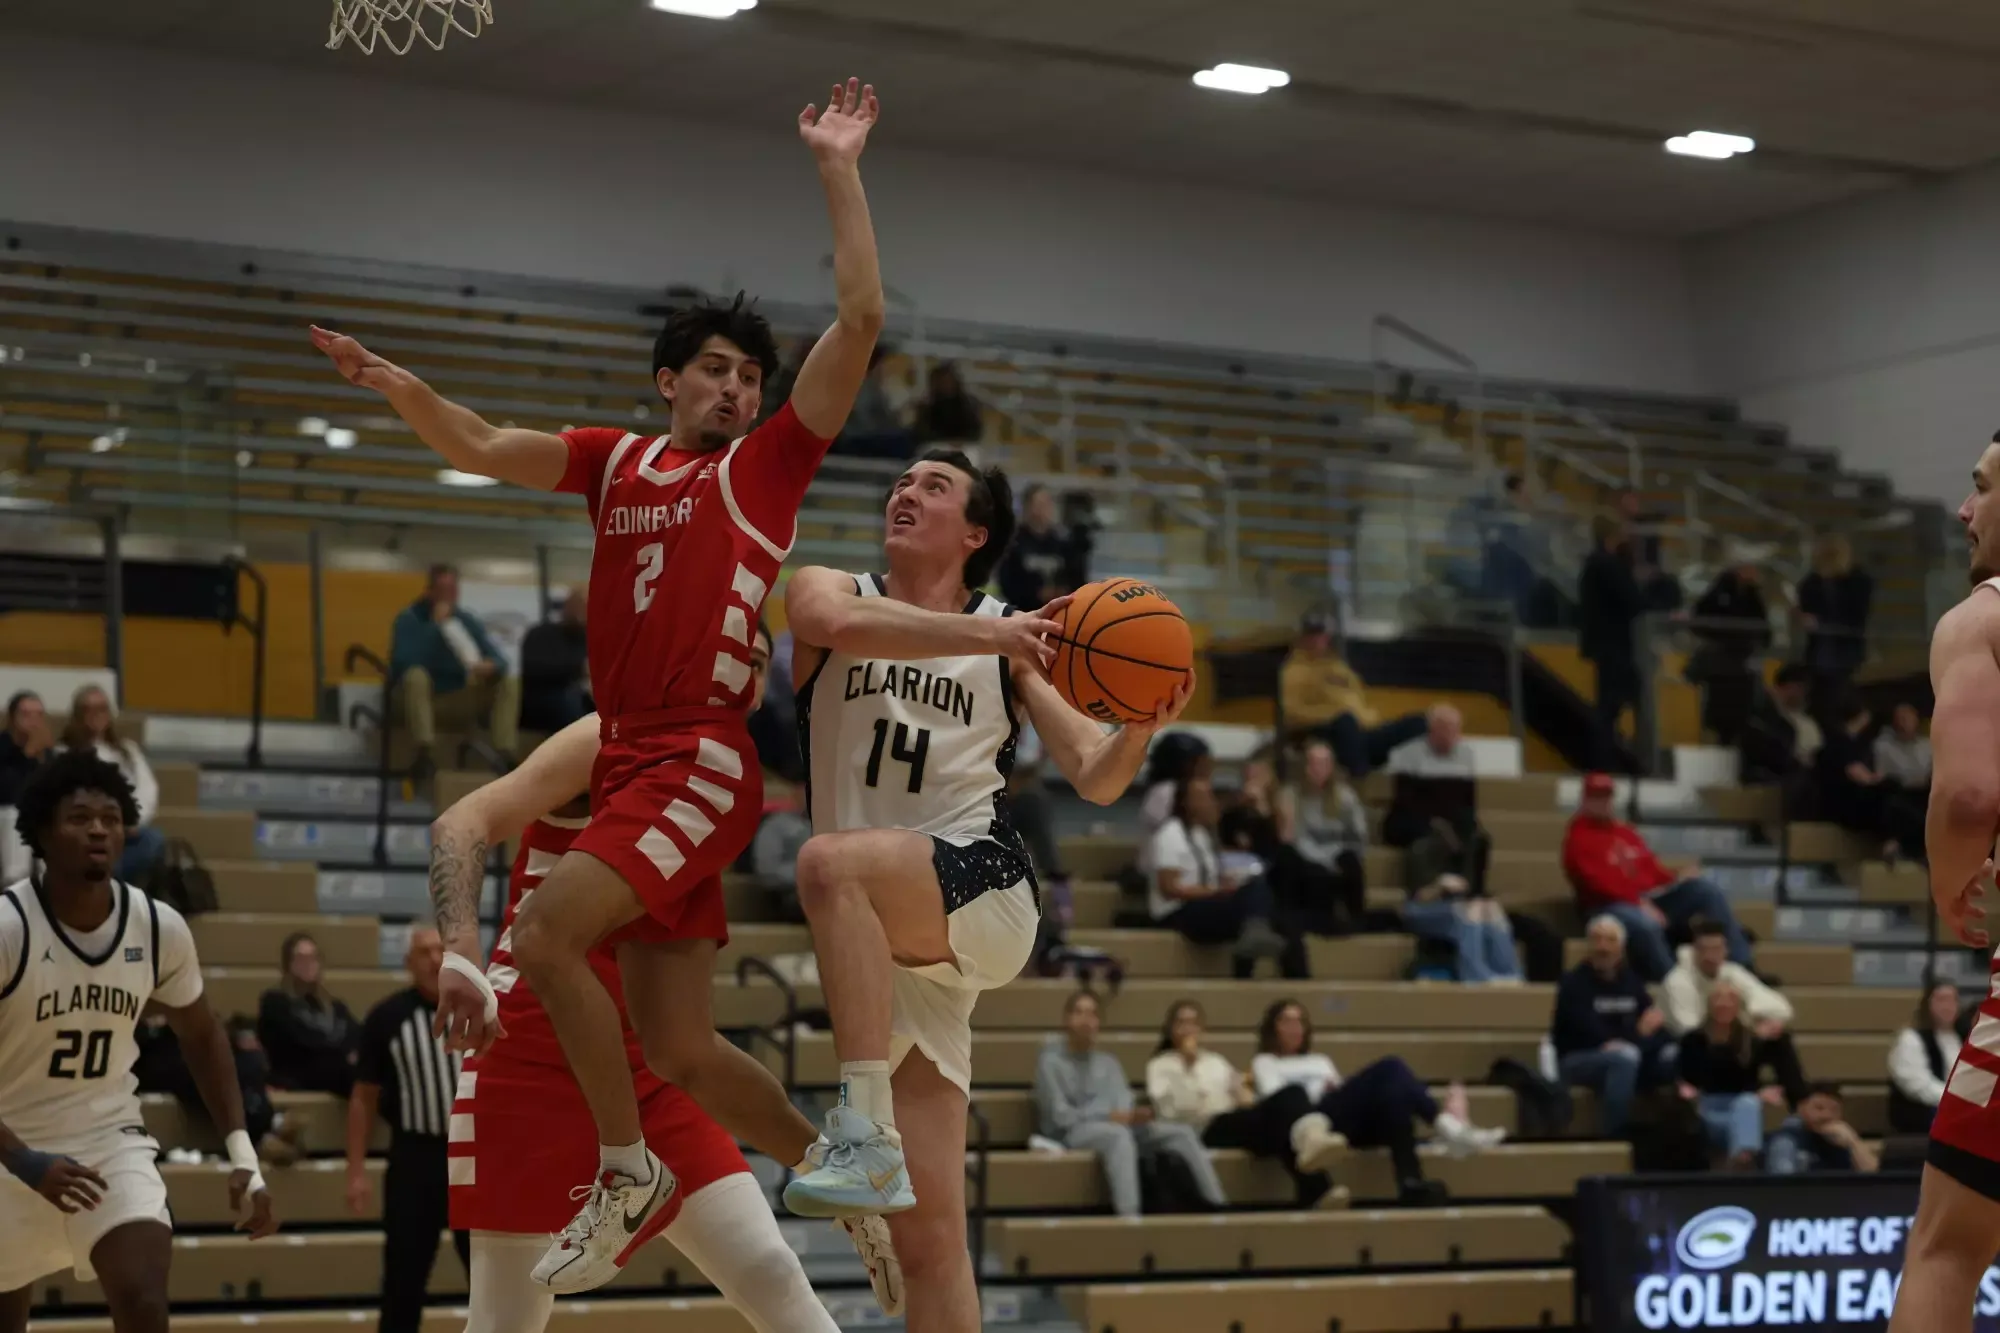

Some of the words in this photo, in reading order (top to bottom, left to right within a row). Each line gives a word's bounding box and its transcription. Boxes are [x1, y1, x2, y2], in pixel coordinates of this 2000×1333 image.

[605, 497, 701, 535] EDINBOR
[633, 542, 664, 614] 2
[845, 662, 974, 727] CLARION
[866, 718, 930, 793] 14
[36, 984, 139, 1022] CLARION
[48, 1029, 113, 1079] 20
[1768, 1219, 1856, 1257] HOME
[1859, 1217, 1905, 1253] OF
[1634, 1270, 1826, 1329] GOLDEN
